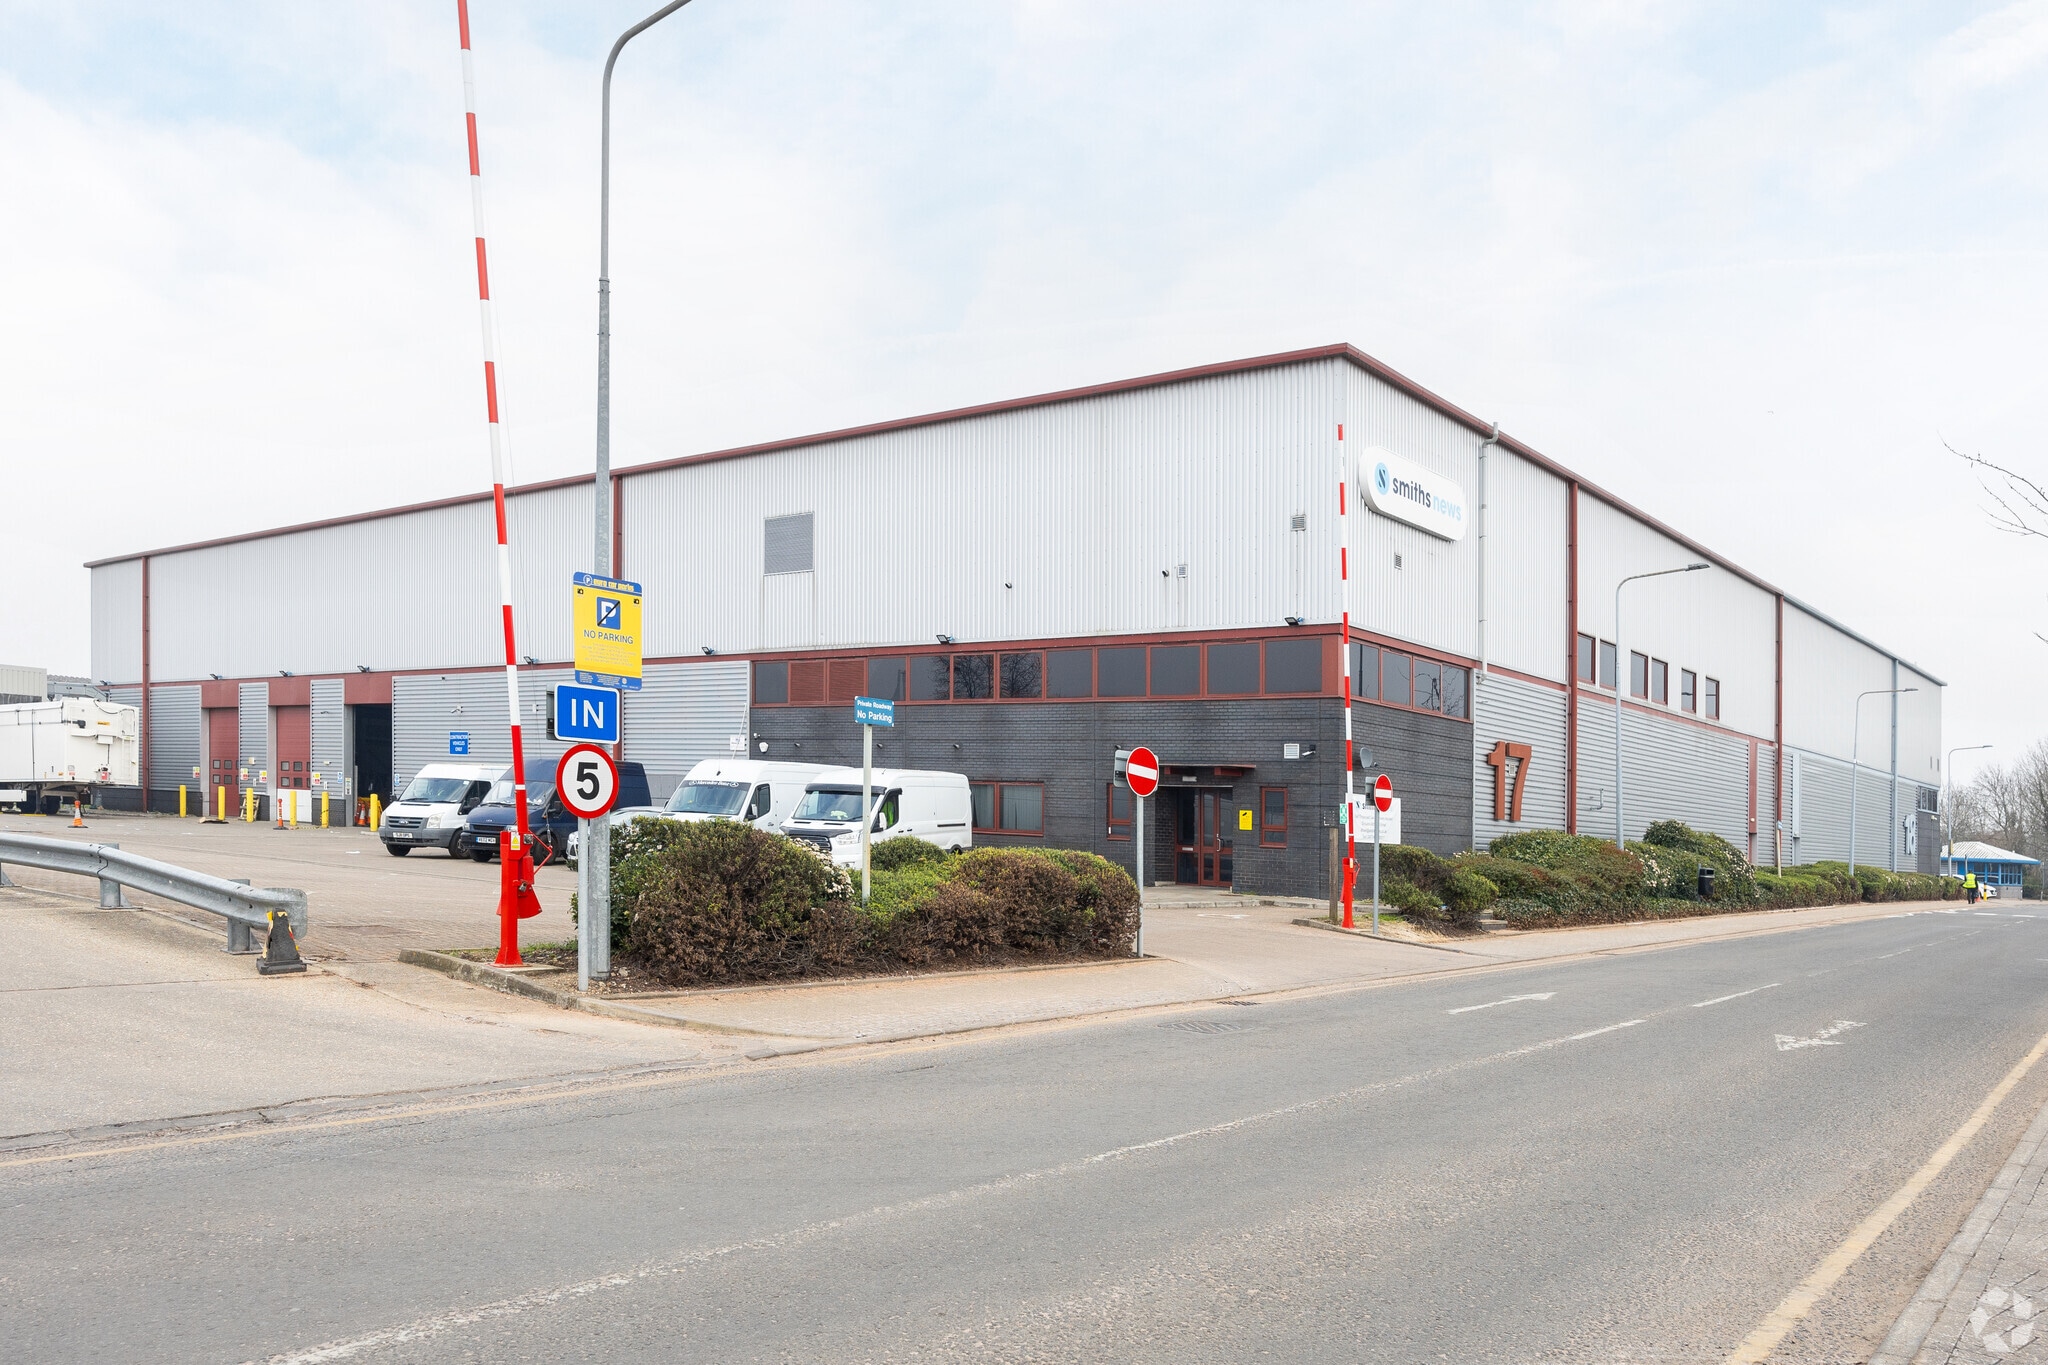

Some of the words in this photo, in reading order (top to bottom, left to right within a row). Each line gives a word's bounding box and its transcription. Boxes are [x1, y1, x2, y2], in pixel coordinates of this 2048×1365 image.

[1393, 477, 1431, 508] smiths
[1433, 496, 1462, 521] news
[583, 629, 596, 639] NO
[598, 631, 634, 645] PARKING
[571, 698, 604, 729] IN
[857, 700, 872, 708] Private
[857, 710, 867, 719] No
[868, 711, 893, 724] Parking
[576, 762, 600, 800] 5
[1487, 740, 1532, 821] 17
